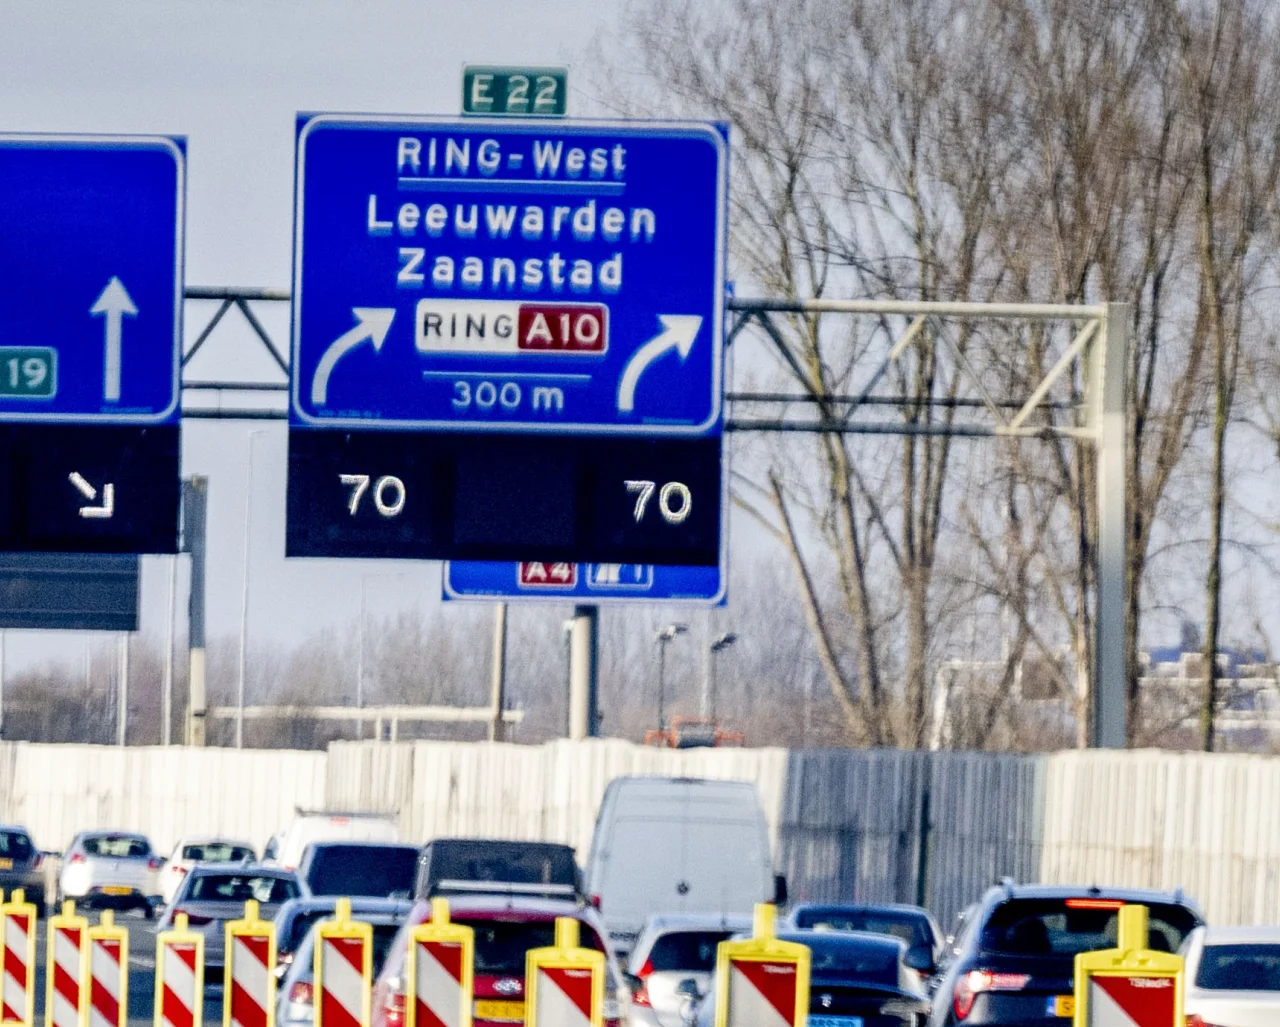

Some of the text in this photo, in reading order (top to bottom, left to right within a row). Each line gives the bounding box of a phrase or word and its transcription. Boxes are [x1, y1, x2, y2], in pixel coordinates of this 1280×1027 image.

[471, 75, 559, 107] E 22
[396, 137, 627, 176] RING-West
[367, 194, 657, 237] Leeuwarden
[396, 247, 624, 289] Zaanstad
[422, 312, 601, 344] RING A10
[451, 380, 564, 412] 300 m
[340, 474, 407, 517] 70
[623, 480, 692, 523] 70
[526, 562, 572, 583] A4
